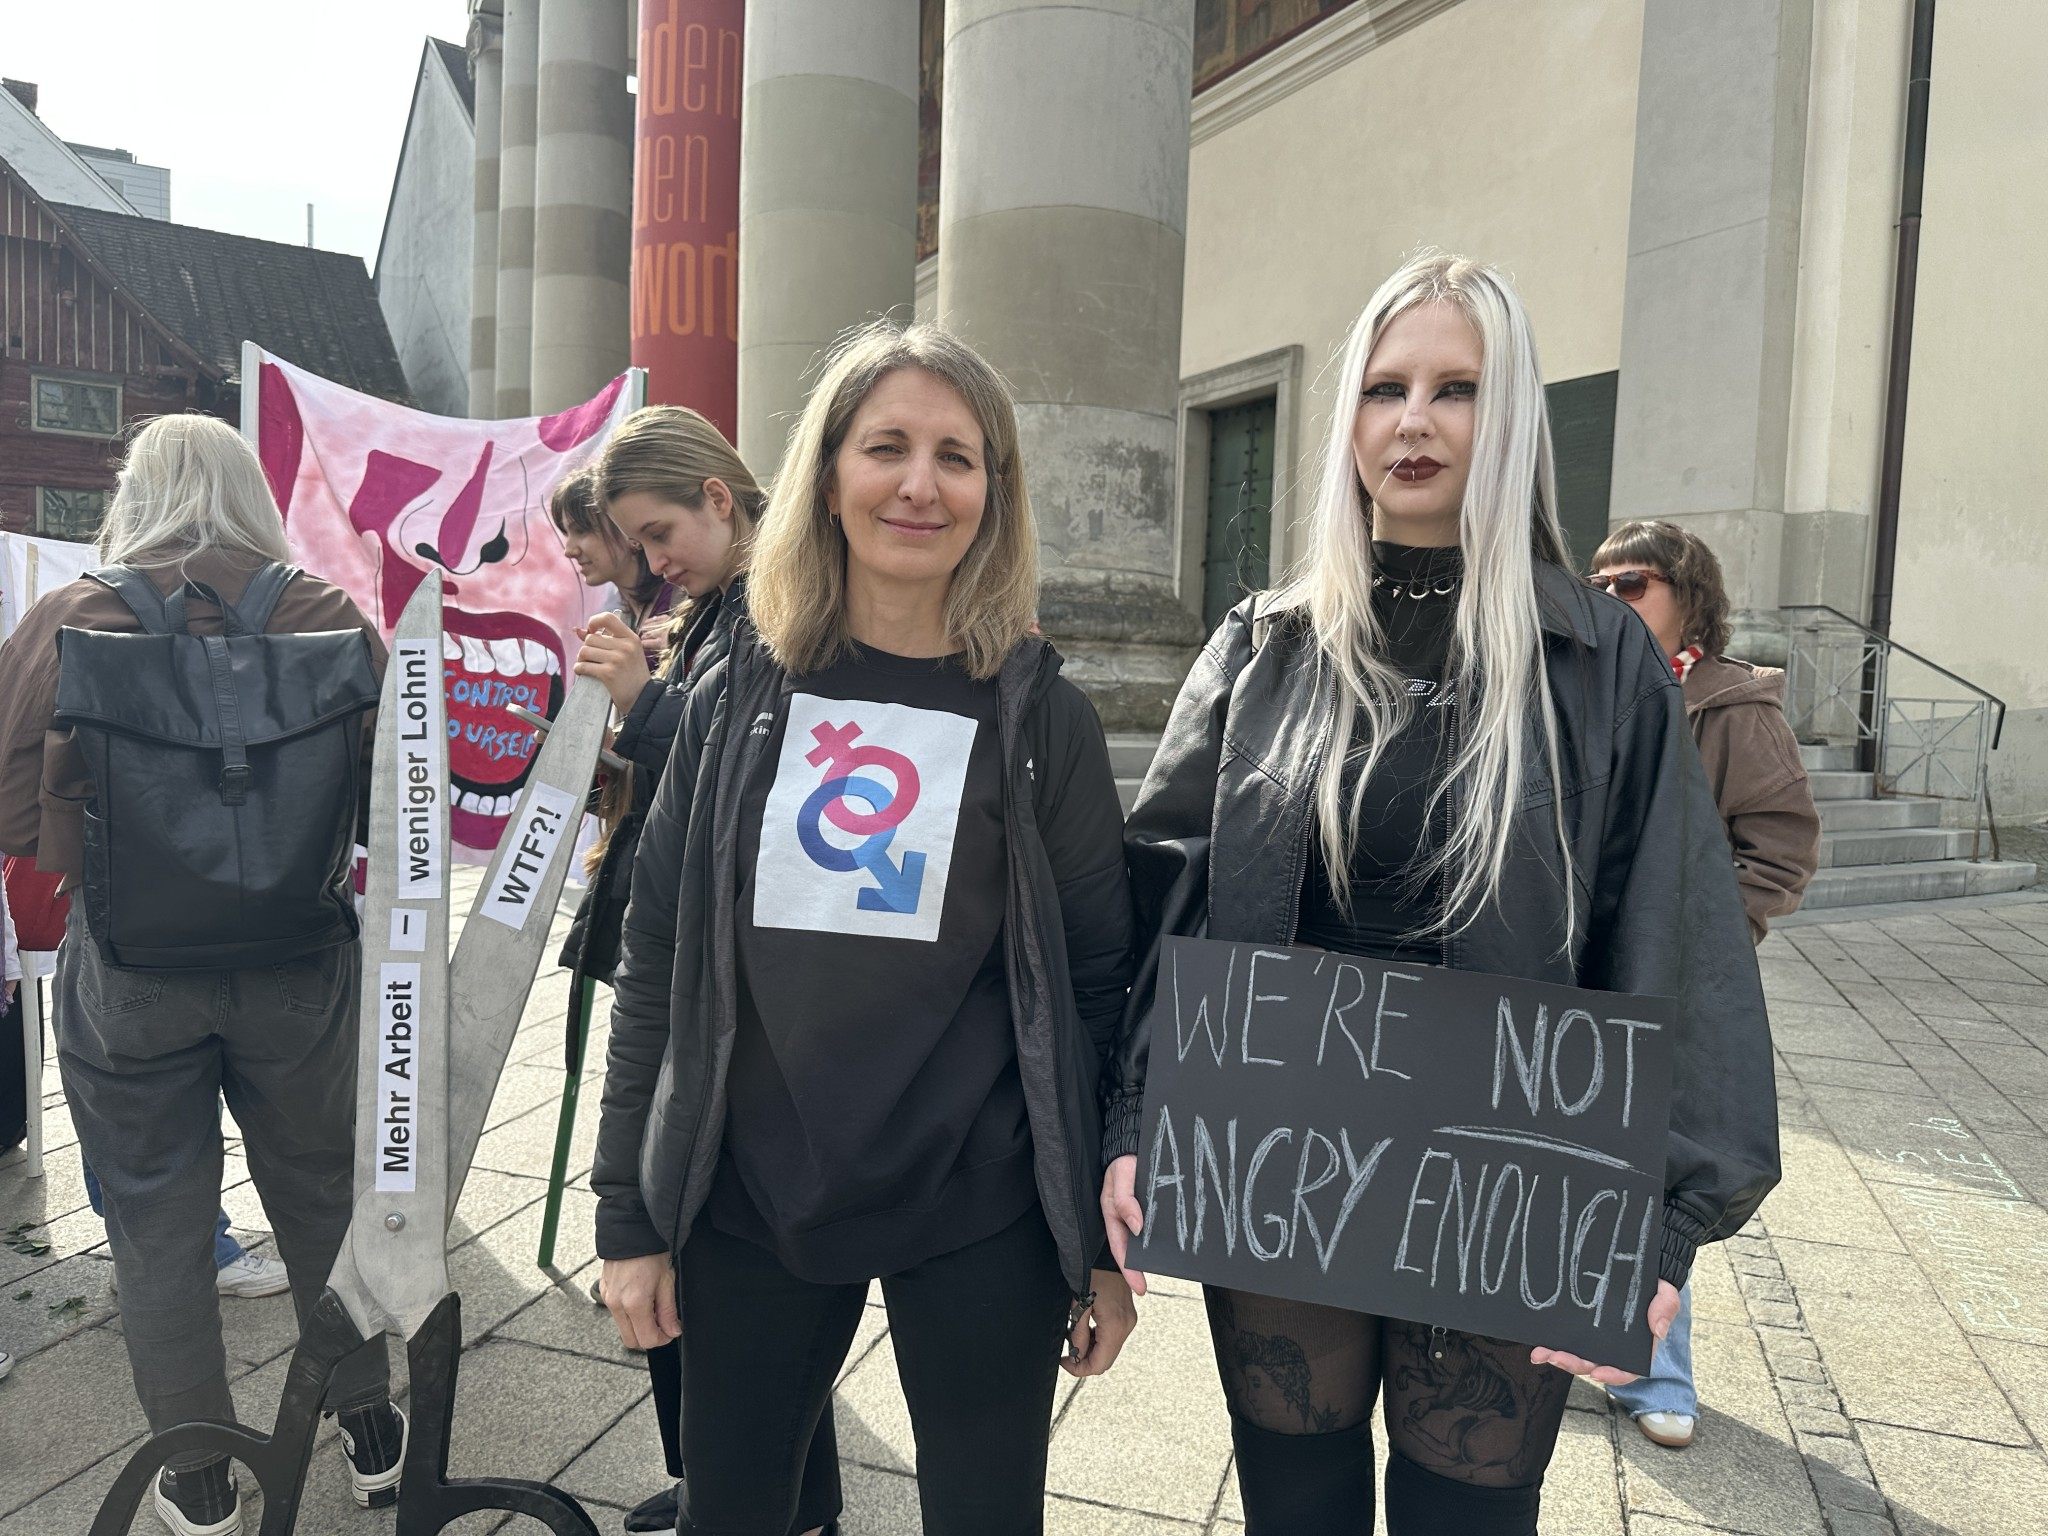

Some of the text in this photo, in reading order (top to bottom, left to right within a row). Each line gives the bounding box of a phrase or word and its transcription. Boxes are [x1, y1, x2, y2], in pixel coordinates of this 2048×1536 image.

[399, 648, 428, 742] Lohn!
[443, 671, 541, 713] ONTROL
[447, 718, 536, 762] OURSELF
[402, 751, 436, 882] weniger
[498, 805, 561, 905] WTF?!
[385, 981, 412, 1080] Arbeit
[1173, 946, 1664, 1127] WE'RE NOT
[383, 1091, 410, 1172] Mehr
[1142, 1105, 1654, 1332] ANGRY ENOUGH
